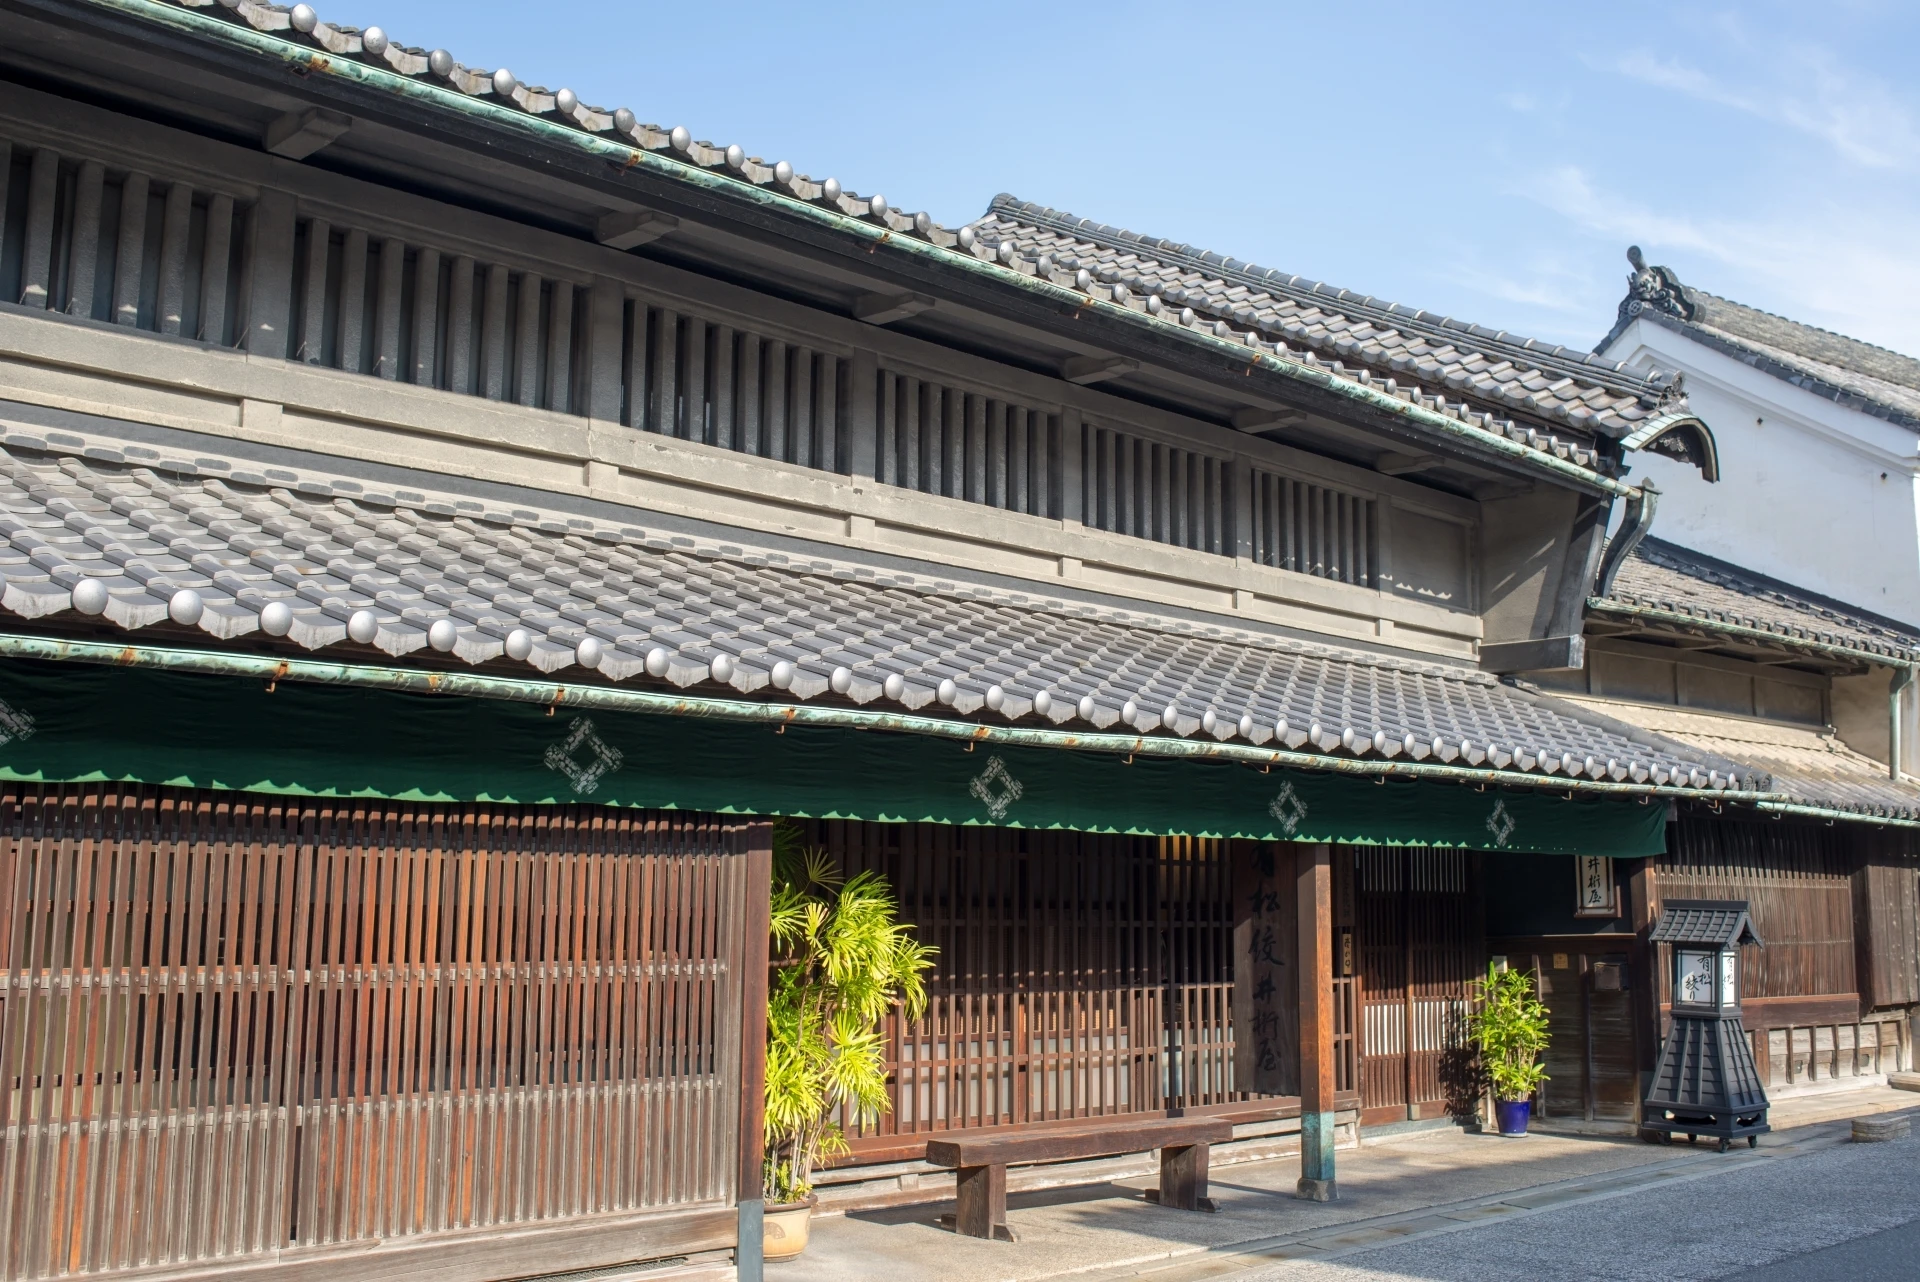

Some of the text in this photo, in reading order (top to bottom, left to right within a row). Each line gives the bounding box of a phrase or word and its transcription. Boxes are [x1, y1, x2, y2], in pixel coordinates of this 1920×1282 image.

[1587, 856, 1602, 904] 井桁屋
[1697, 955, 1713, 986] 有松
[1685, 974, 1700, 1001] 絞り
